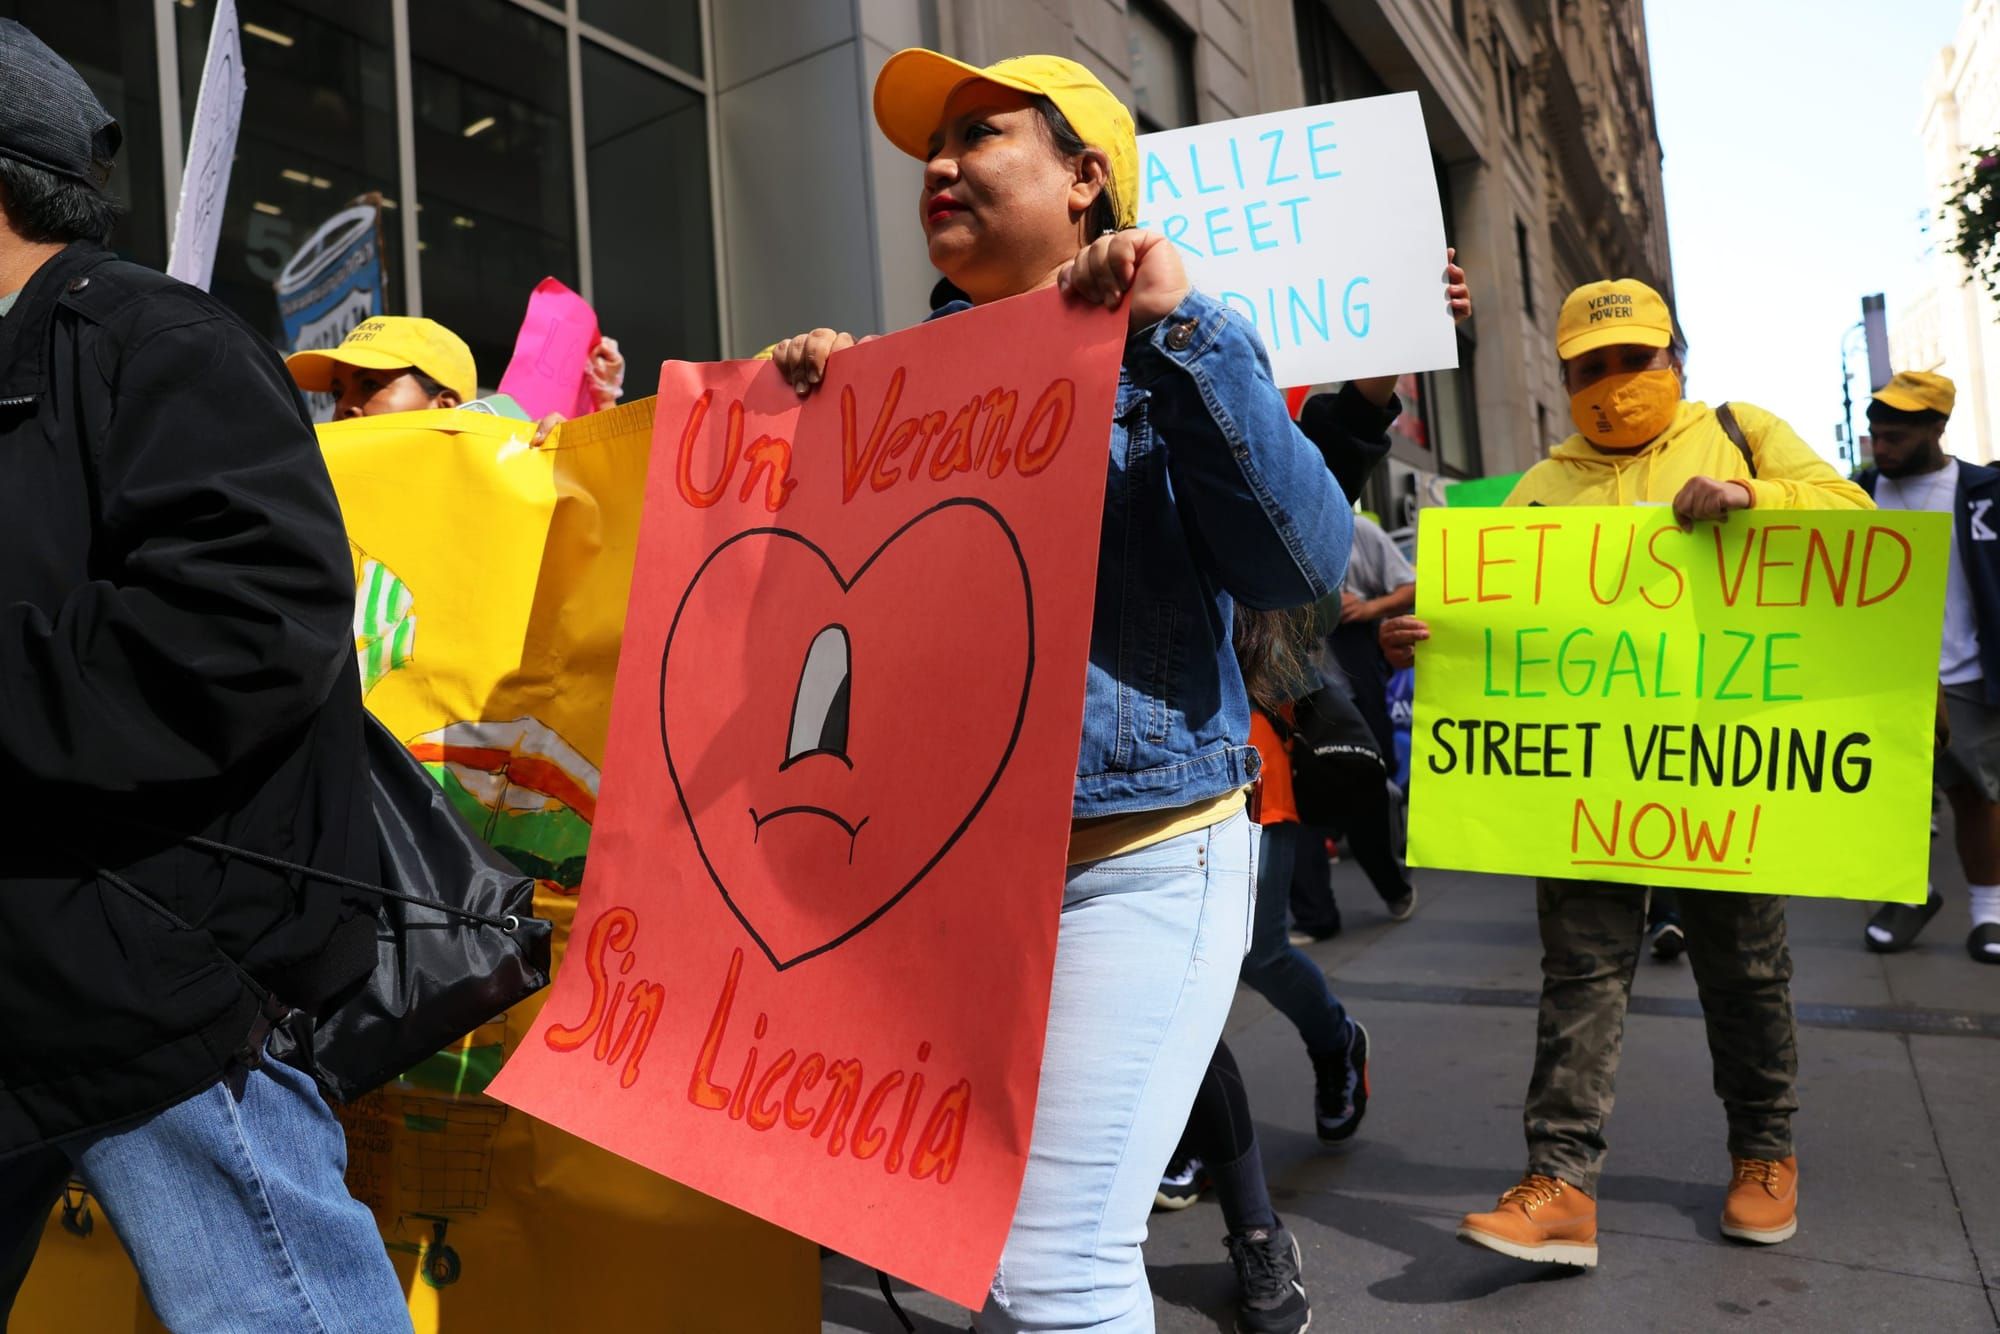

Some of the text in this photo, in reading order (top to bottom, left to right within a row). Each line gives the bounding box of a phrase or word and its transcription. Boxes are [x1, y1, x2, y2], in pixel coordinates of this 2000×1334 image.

[1146, 120, 1342, 204] ALIZE
[1136, 196, 1311, 259] REET
[1588, 293, 1633, 310] VENDOR
[1589, 307, 1633, 324] POWER!
[675, 365, 1076, 512] Un Verano
[1441, 522, 1913, 609] LET US VEND
[1482, 626, 1804, 702] LEGALIZE
[1427, 716, 1873, 794] STREET VENDING
[1571, 798, 1762, 865] NOW!
[543, 905, 972, 1185] Sin Licencia
